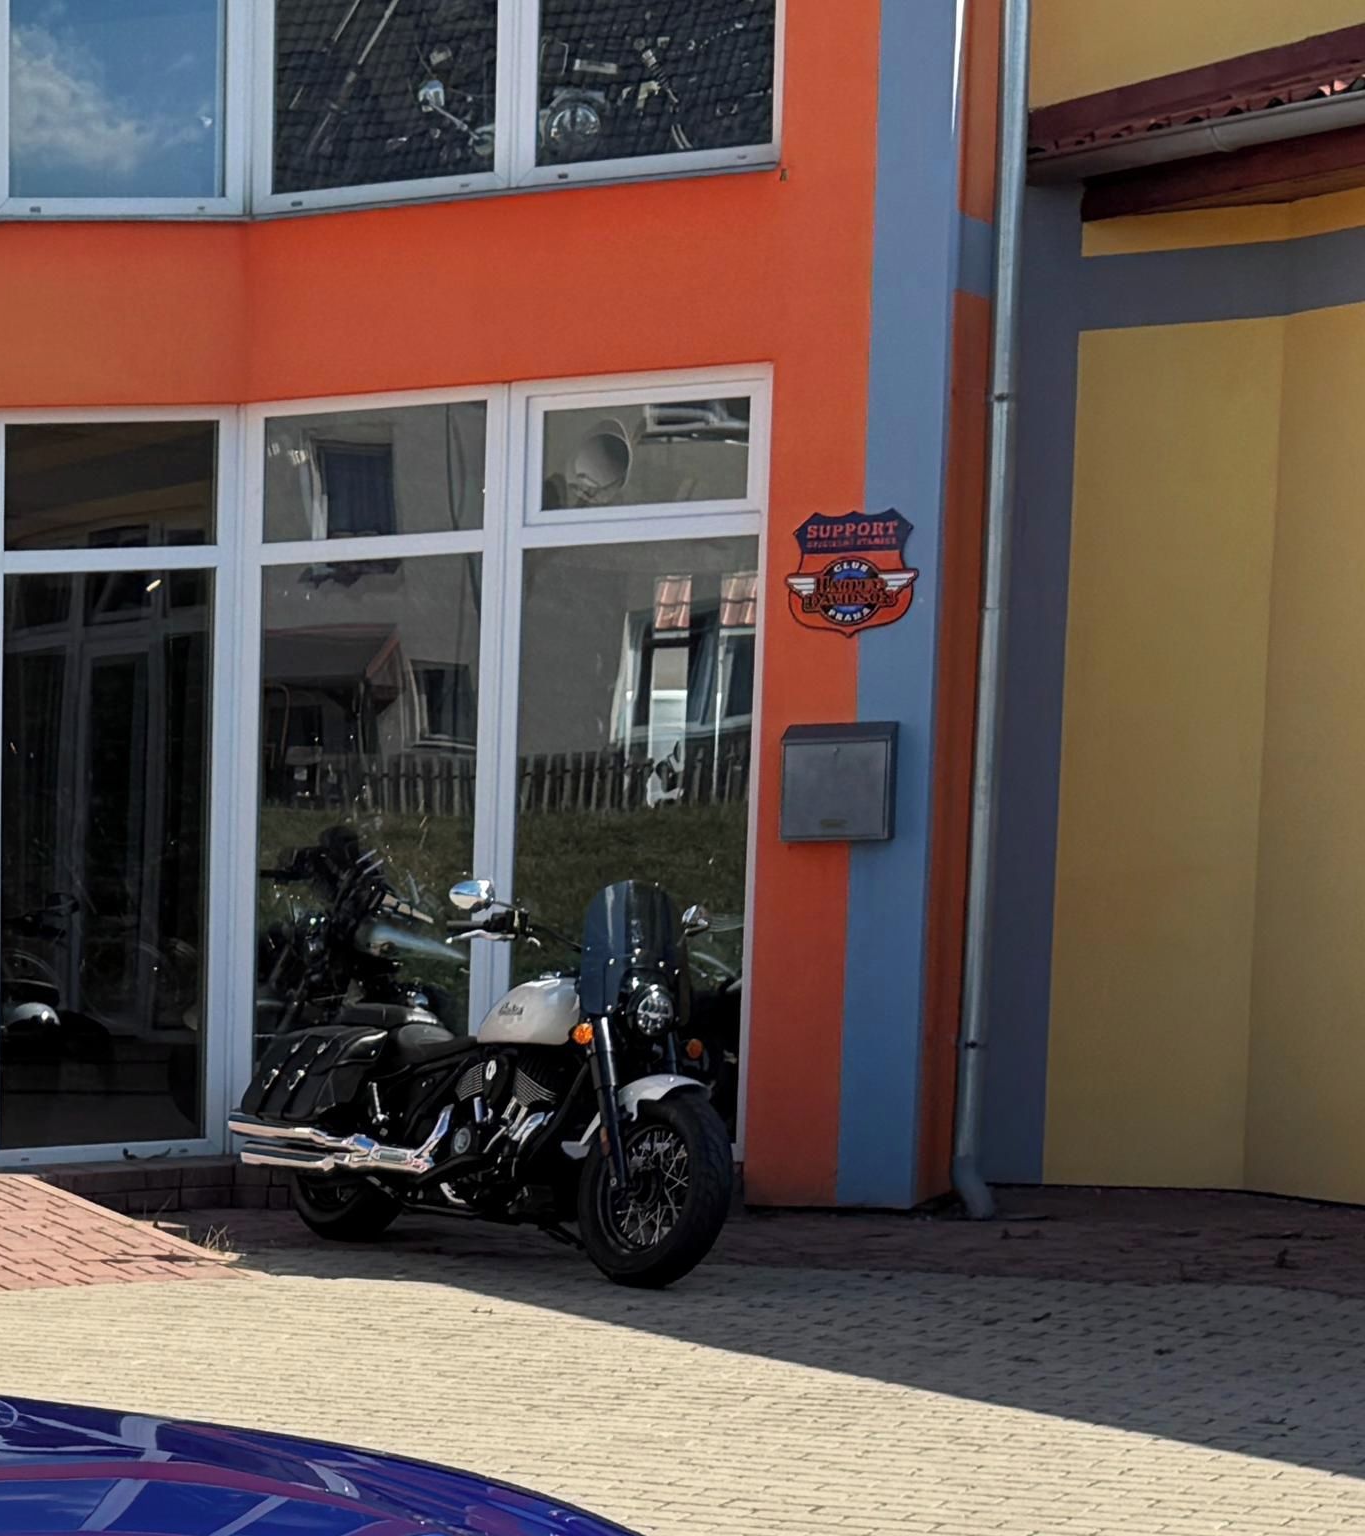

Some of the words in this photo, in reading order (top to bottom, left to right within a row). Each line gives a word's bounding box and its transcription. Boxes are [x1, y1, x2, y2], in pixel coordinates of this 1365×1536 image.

[806, 519, 899, 538] SUPPORT
[833, 560, 869, 573] CLUB
[827, 607, 872, 622] PRAHA
